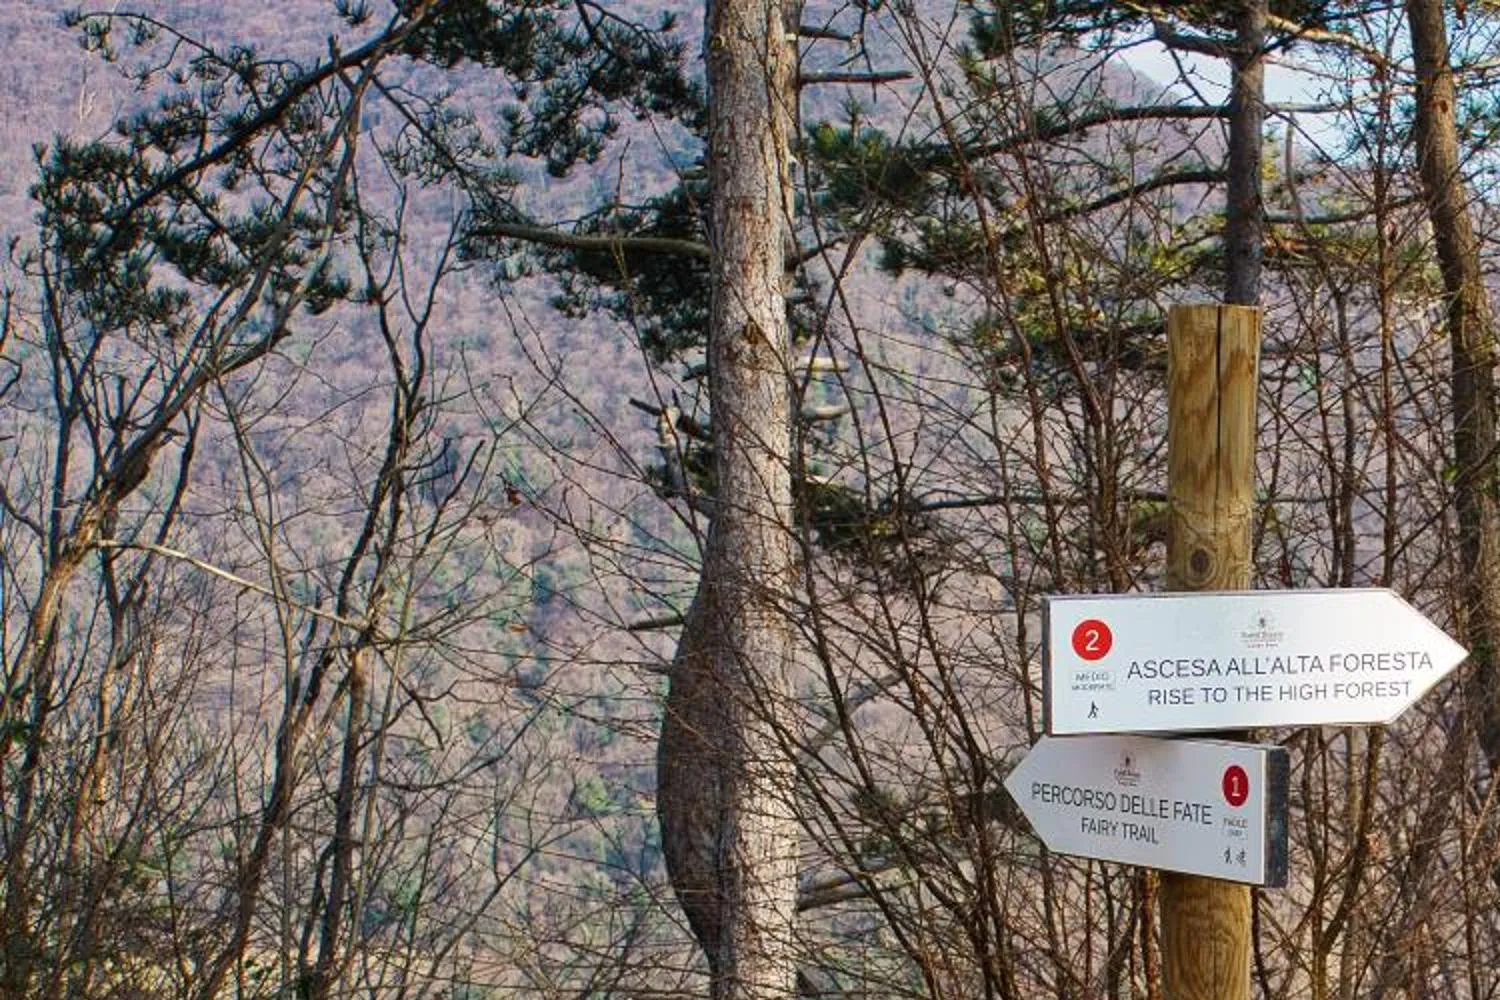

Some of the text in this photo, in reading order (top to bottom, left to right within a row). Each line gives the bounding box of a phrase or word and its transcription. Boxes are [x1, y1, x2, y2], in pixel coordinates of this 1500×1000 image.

[1084, 629, 1100, 651] 2
[1127, 652, 1434, 679] ASCESA ALL'ALTA FORESTA
[1148, 681, 1412, 705] RISE TO THE HIGH FOREST
[1230, 775, 1242, 798] 1
[1031, 781, 1117, 811] PERCORSO
[1120, 795, 1169, 819] DELLE
[1173, 801, 1213, 825] FATE
[1081, 817, 1159, 845] FAIRY TRAIL
